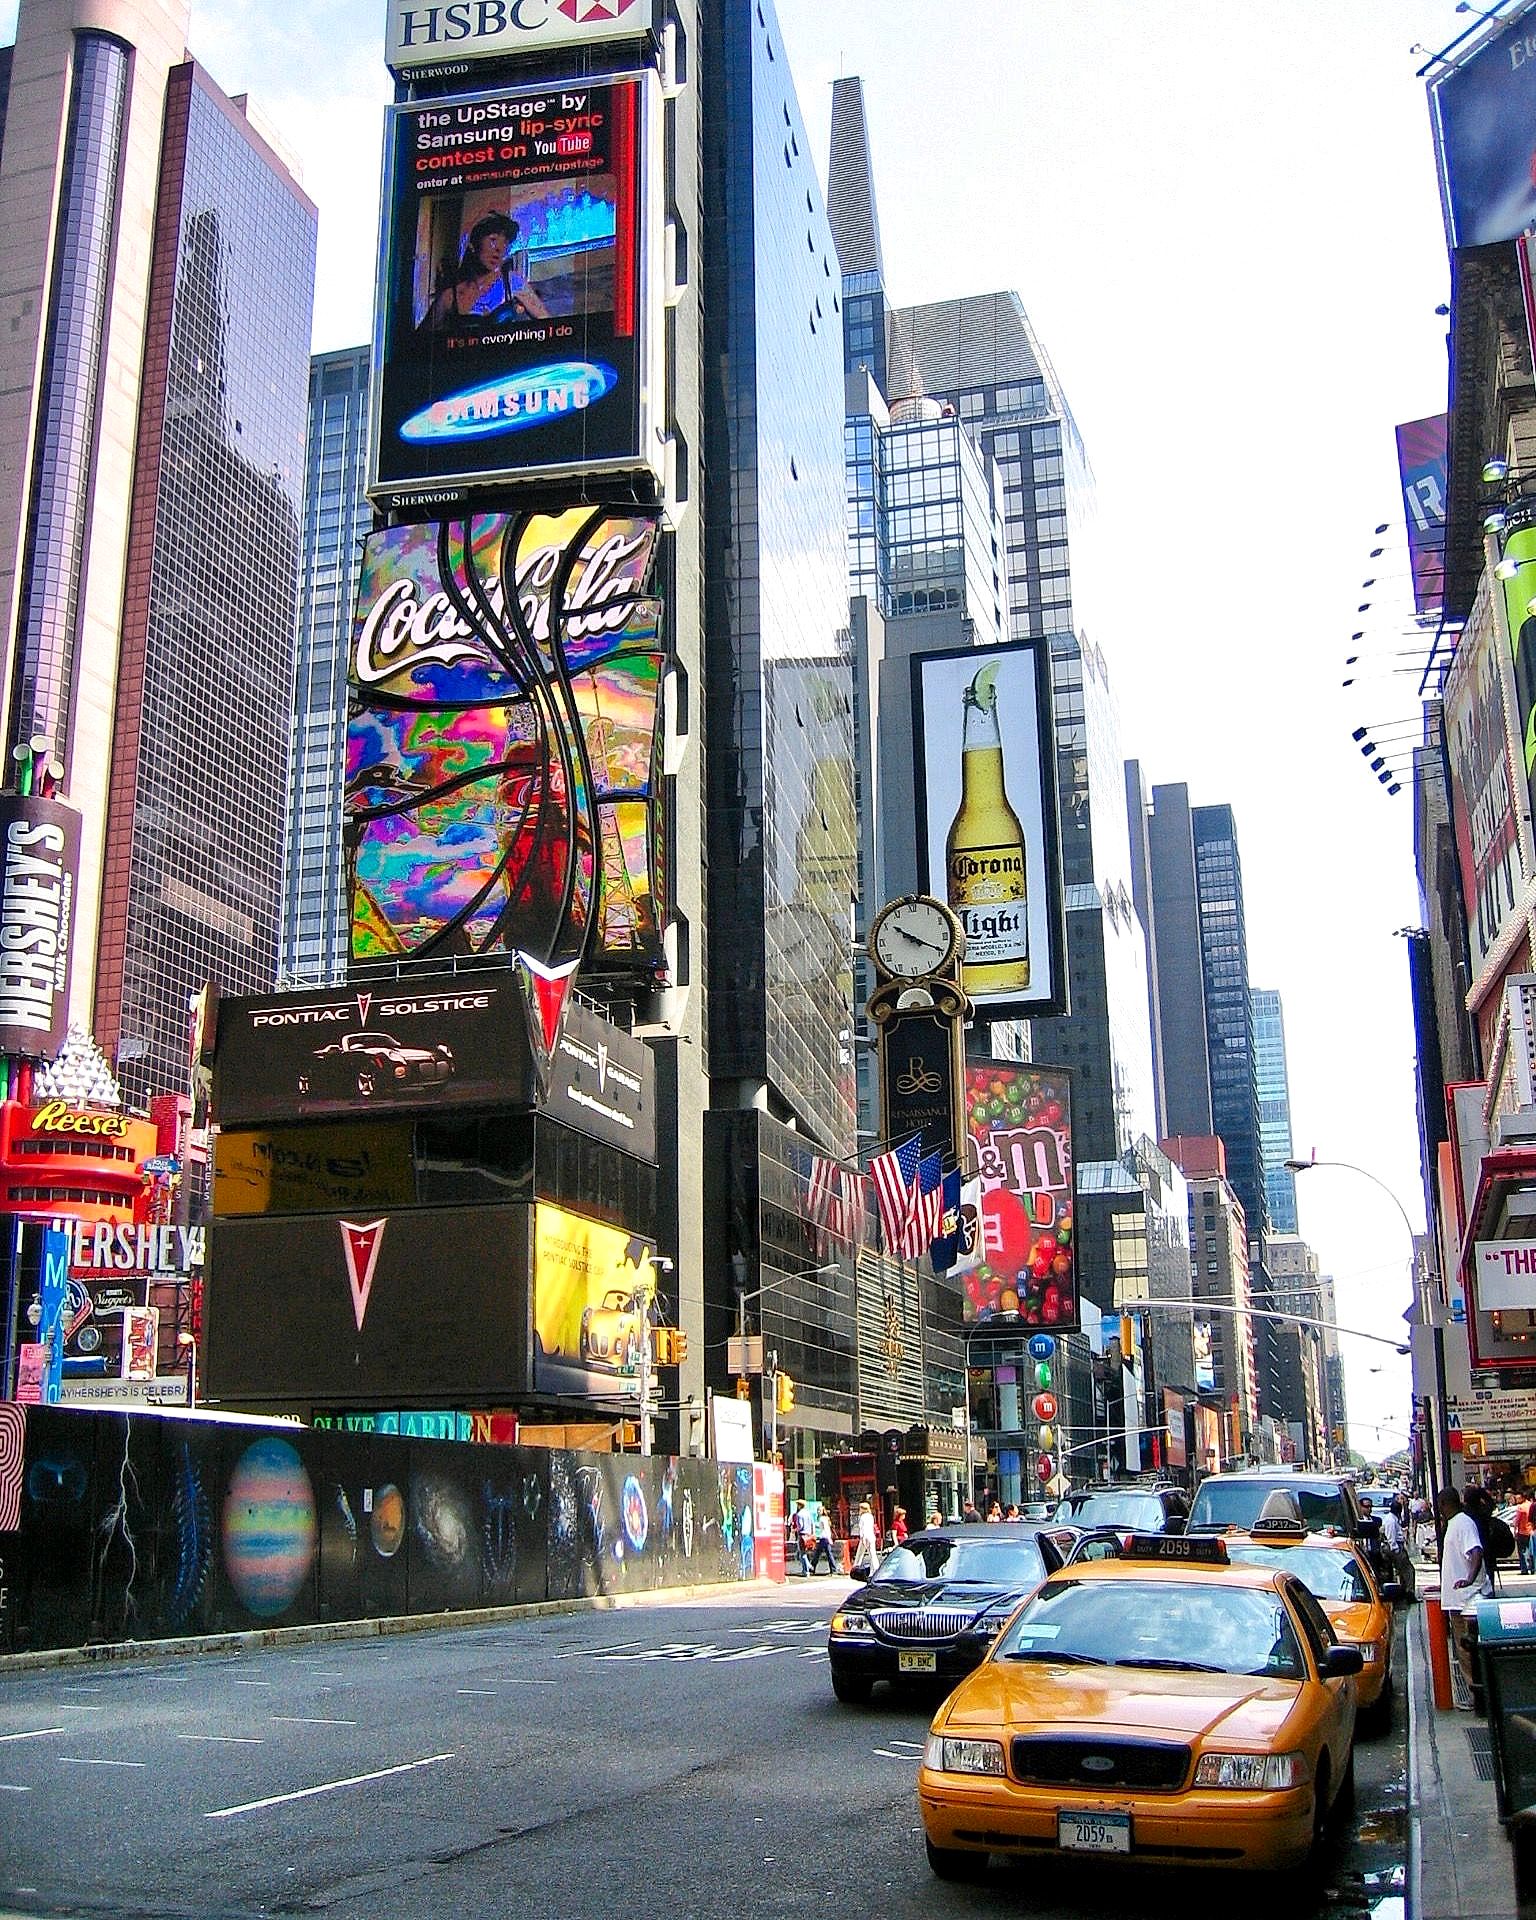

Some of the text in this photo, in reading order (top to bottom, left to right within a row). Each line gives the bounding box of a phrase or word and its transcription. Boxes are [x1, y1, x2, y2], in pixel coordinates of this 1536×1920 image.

[398, 0, 549, 47] HSBC
[401, 65, 469, 81] SHERWOOD
[418, 112, 451, 129] the
[561, 94, 587, 111] by
[416, 114, 604, 150] Samsung lip-sync
[416, 147, 495, 171] contest
[500, 145, 526, 159] on
[451, 174, 463, 186] at
[465, 157, 604, 183] samsung.com/upstage
[481, 328, 546, 345] everything
[555, 324, 573, 337] do
[391, 490, 459, 507] SHERWOOD
[952, 855, 1022, 879] Corona
[0, 820, 65, 1032] HERSHEY'S
[54, 872, 73, 993] Milk Chocolate
[960, 910, 1019, 939] Light
[253, 996, 488, 1027] PONTIAC SOLSTICE
[560, 1039, 641, 1093] PONTIAC GARAGE
[32, 1100, 131, 1137] Reese's
[1035, 1342, 1045, 1352] m
[75, 1386, 128, 1398] HERSHEY'S
[130, 1387, 139, 1396] IS
[1043, 1403, 1053, 1412] m
[383, 1414, 493, 1443] GARDEN
[1159, 1540, 1190, 1556] 2D59
[1076, 1825, 1105, 1842] 2D59
